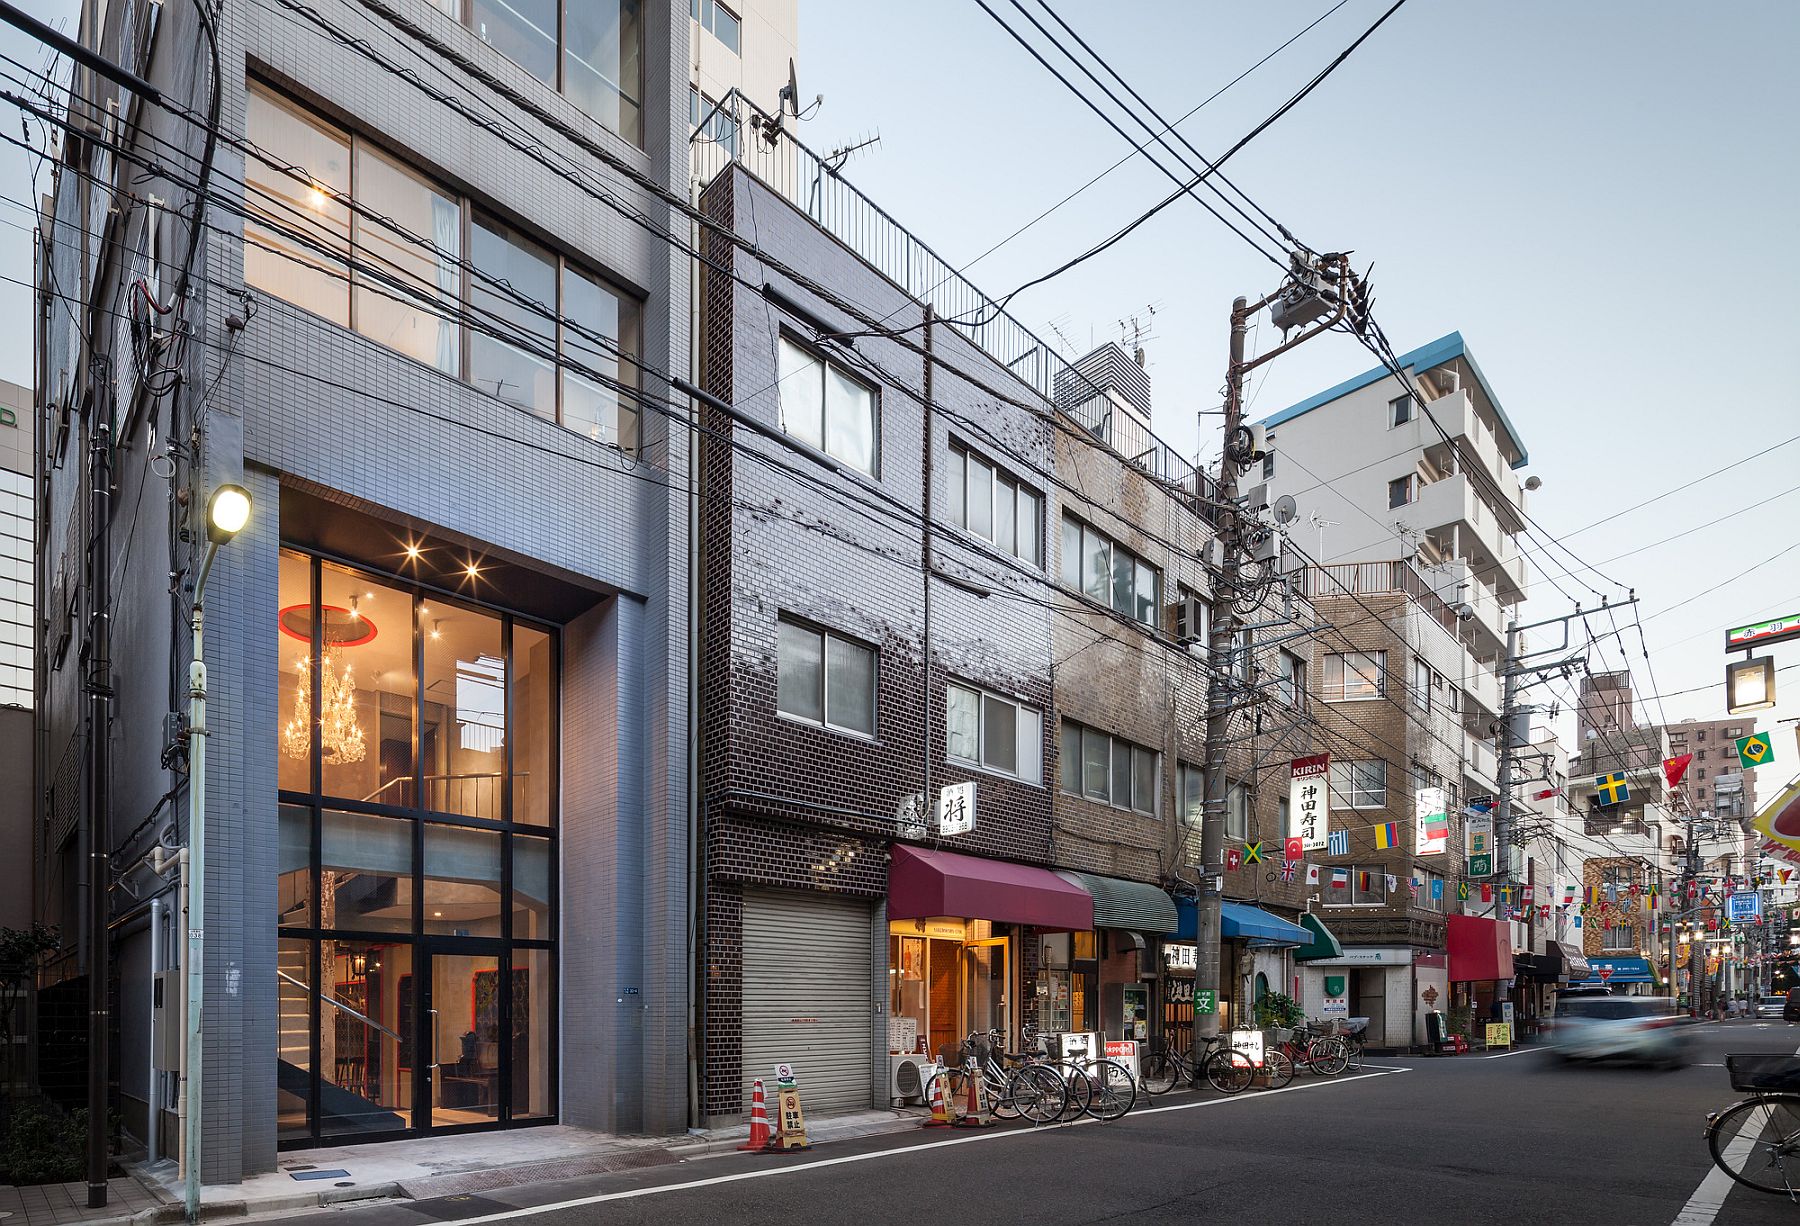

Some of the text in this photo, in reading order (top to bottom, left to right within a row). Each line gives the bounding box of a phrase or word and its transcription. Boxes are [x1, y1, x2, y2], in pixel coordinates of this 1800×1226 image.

[944, 795, 967, 822] 将
[1300, 785, 1318, 840] 神田寿司
[1196, 997, 1211, 1010] 文
[786, 1111, 799, 1120] 駐車
[787, 1120, 800, 1129] 禁止
